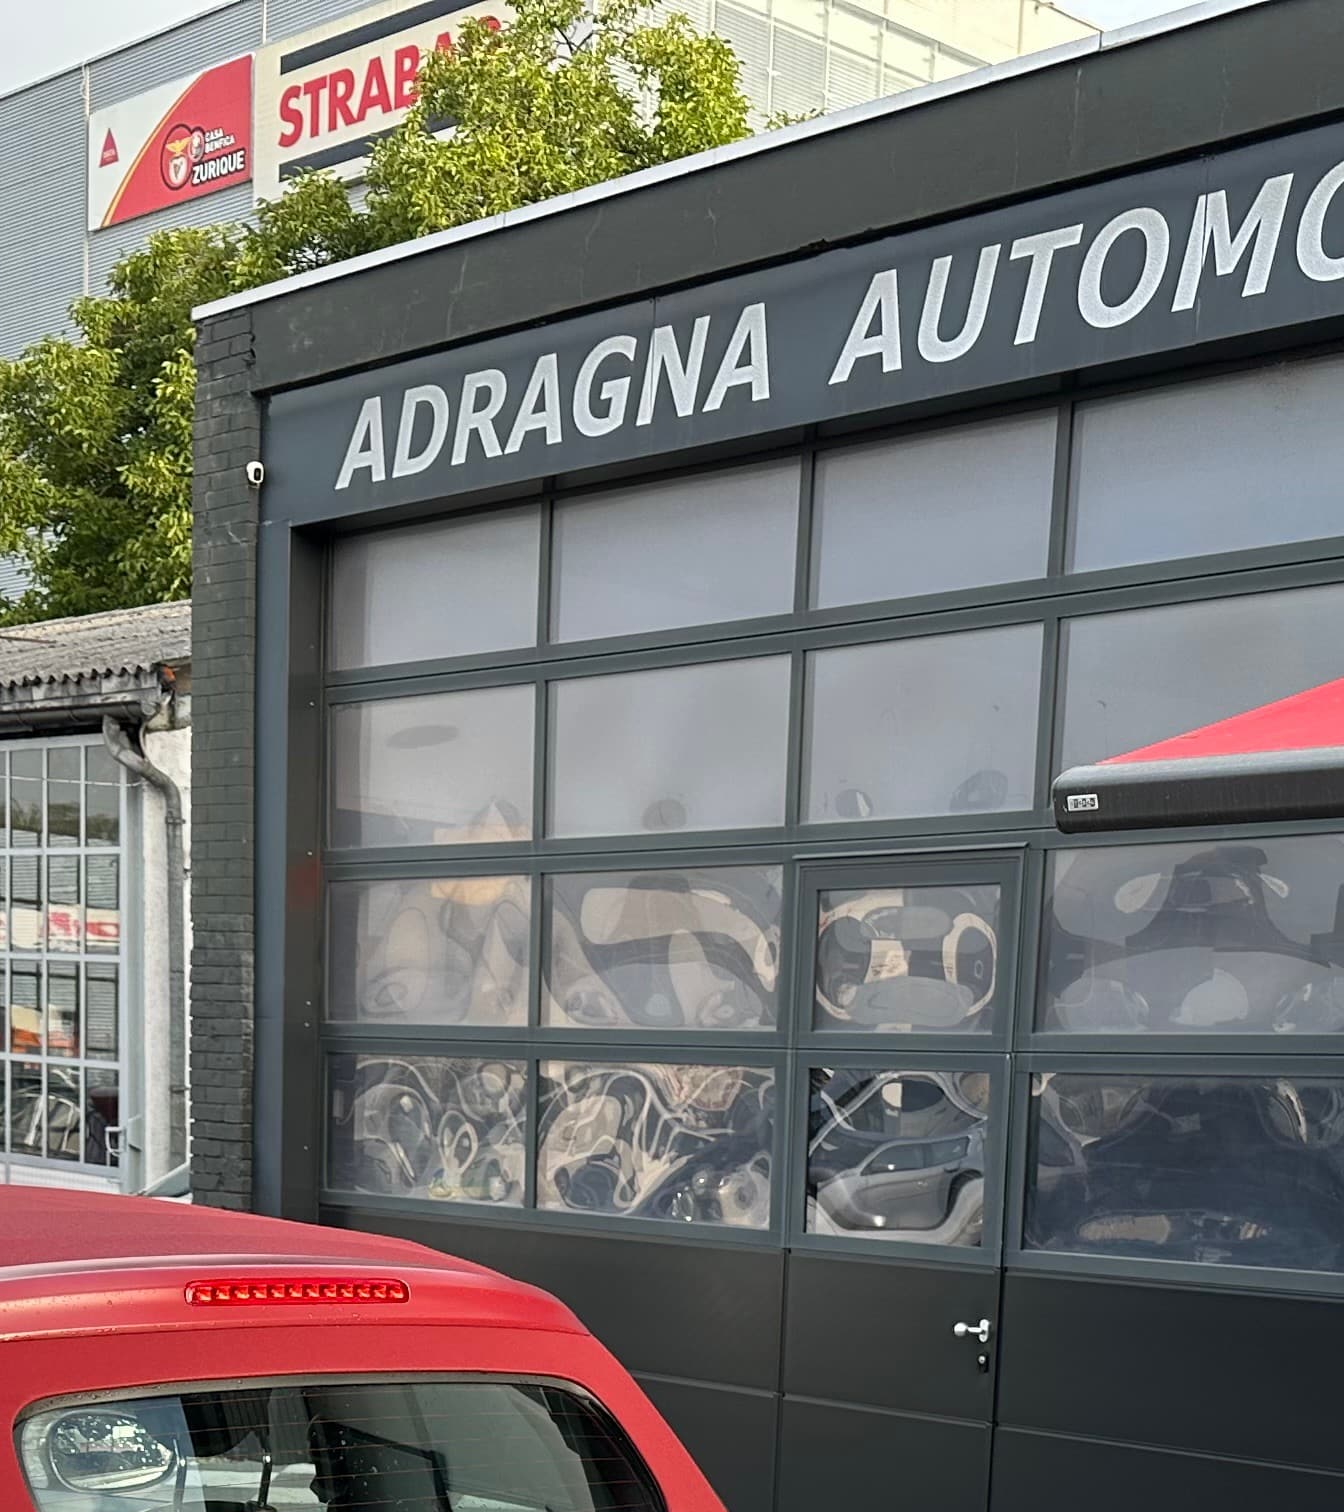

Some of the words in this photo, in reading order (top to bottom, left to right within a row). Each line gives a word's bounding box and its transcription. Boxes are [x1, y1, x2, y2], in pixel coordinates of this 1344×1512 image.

[278, 15, 501, 148] STRAB
[192, 150, 245, 185] ZURIQUE
[205, 127, 223, 142] CASA
[334, 302, 770, 490] ADRAGNA
